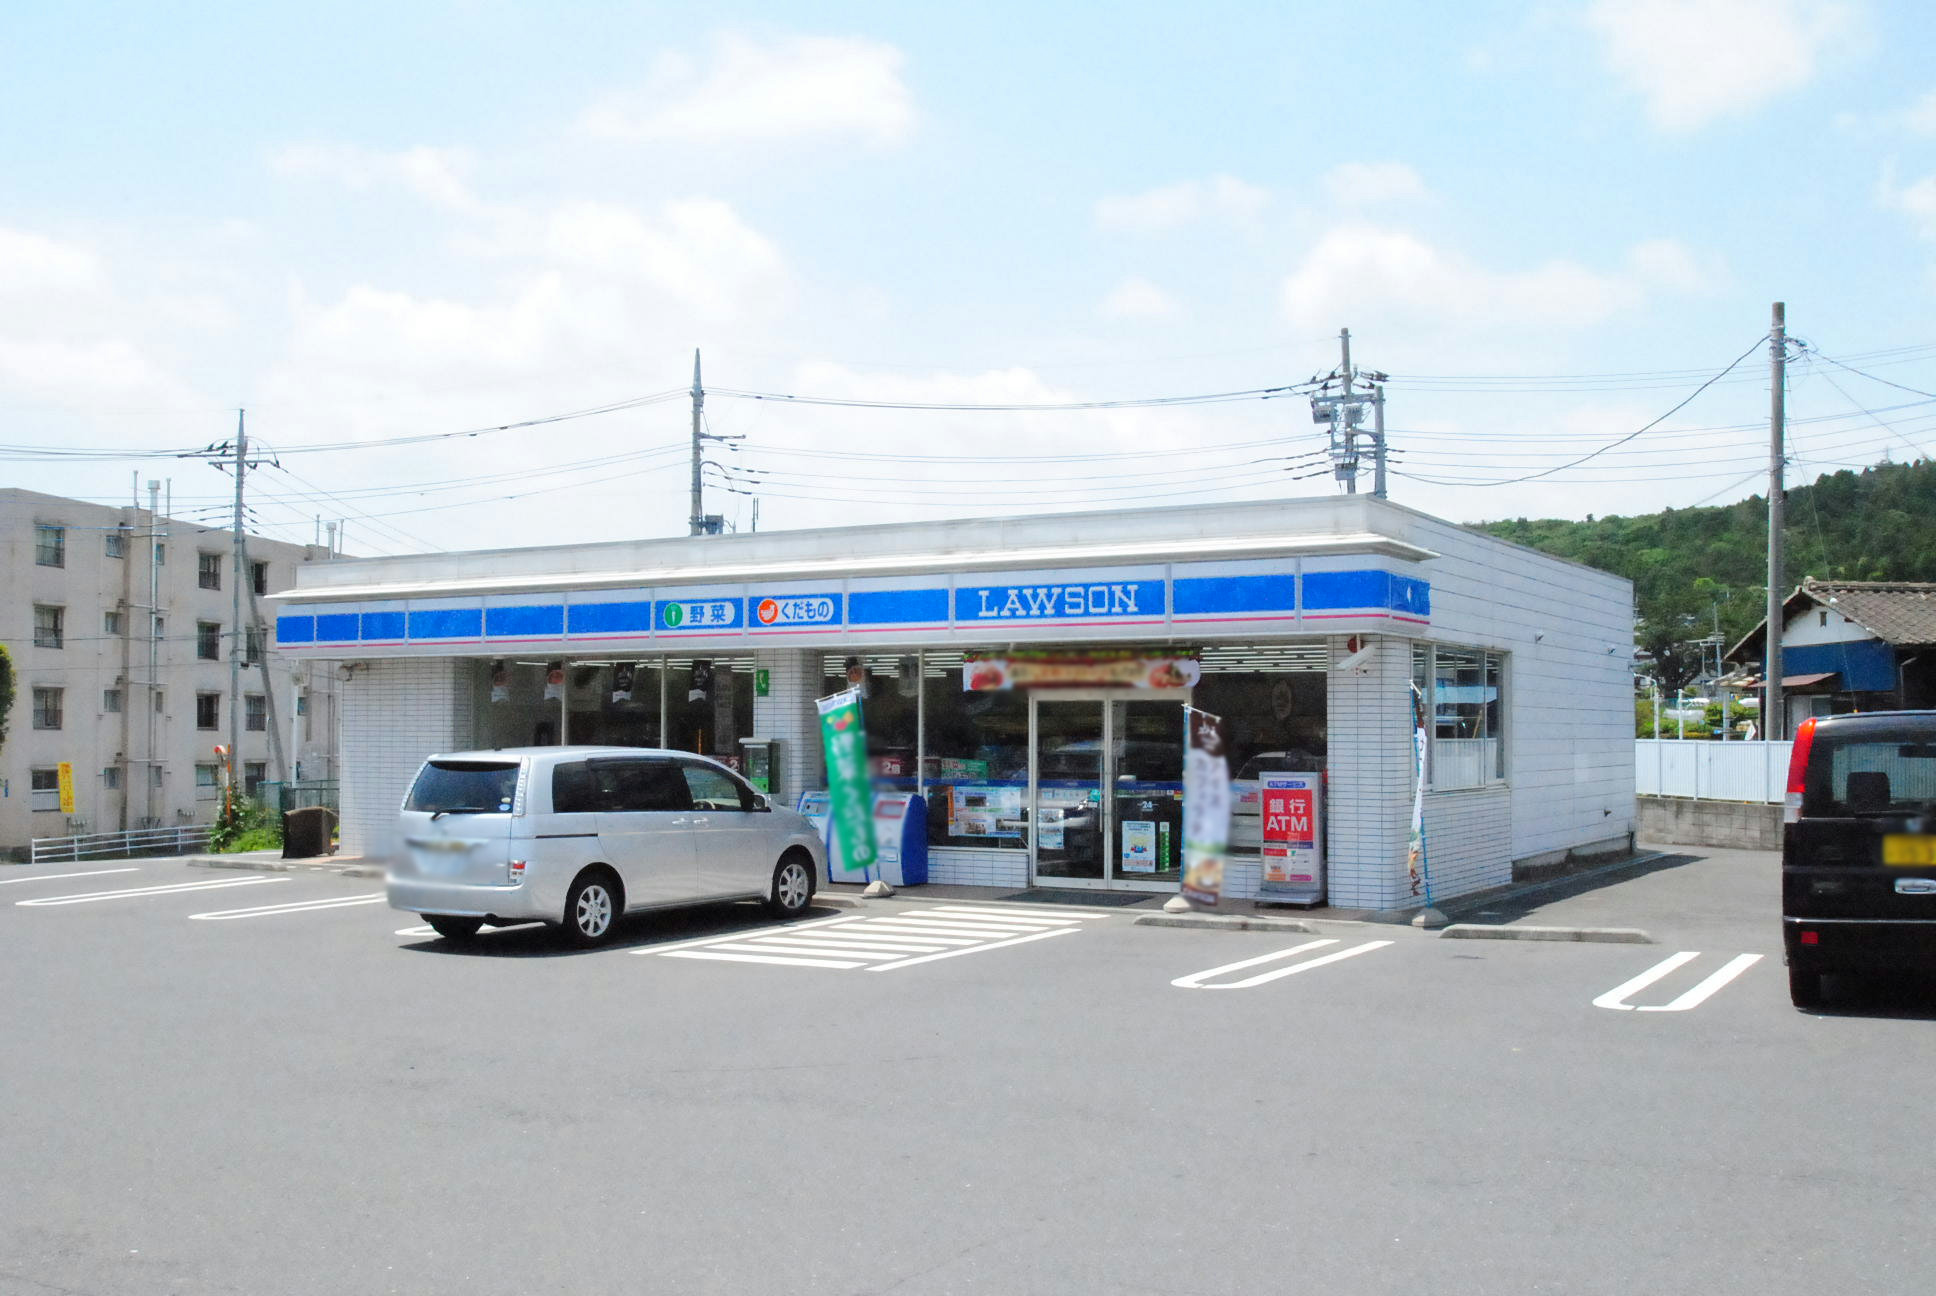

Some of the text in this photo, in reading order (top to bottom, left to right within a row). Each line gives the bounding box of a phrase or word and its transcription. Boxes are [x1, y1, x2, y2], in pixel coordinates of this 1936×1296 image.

[978, 584, 1139, 617] LAWSON
[689, 604, 726, 623] 野菜
[781, 601, 829, 620] くだもの
[1269, 798, 1306, 814] 銀行
[1266, 815, 1308, 831] ATM
